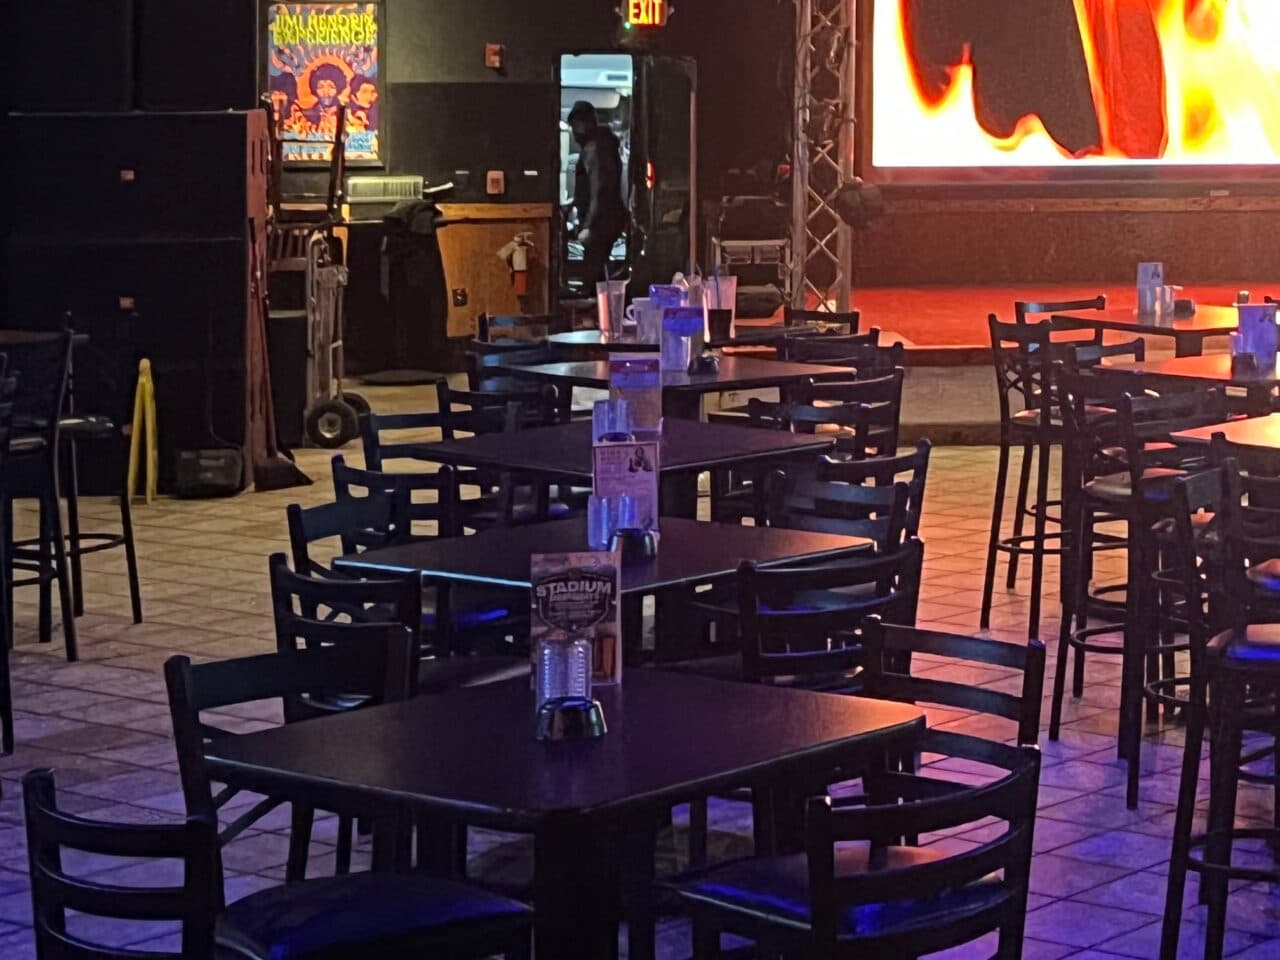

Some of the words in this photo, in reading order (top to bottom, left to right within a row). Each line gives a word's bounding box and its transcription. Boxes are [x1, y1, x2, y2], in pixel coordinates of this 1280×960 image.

[275, 14, 304, 32] JIMI
[307, 14, 375, 32] HENDRIX
[273, 28, 375, 46] EXPERIENCE
[536, 580, 611, 597] STADIUM
